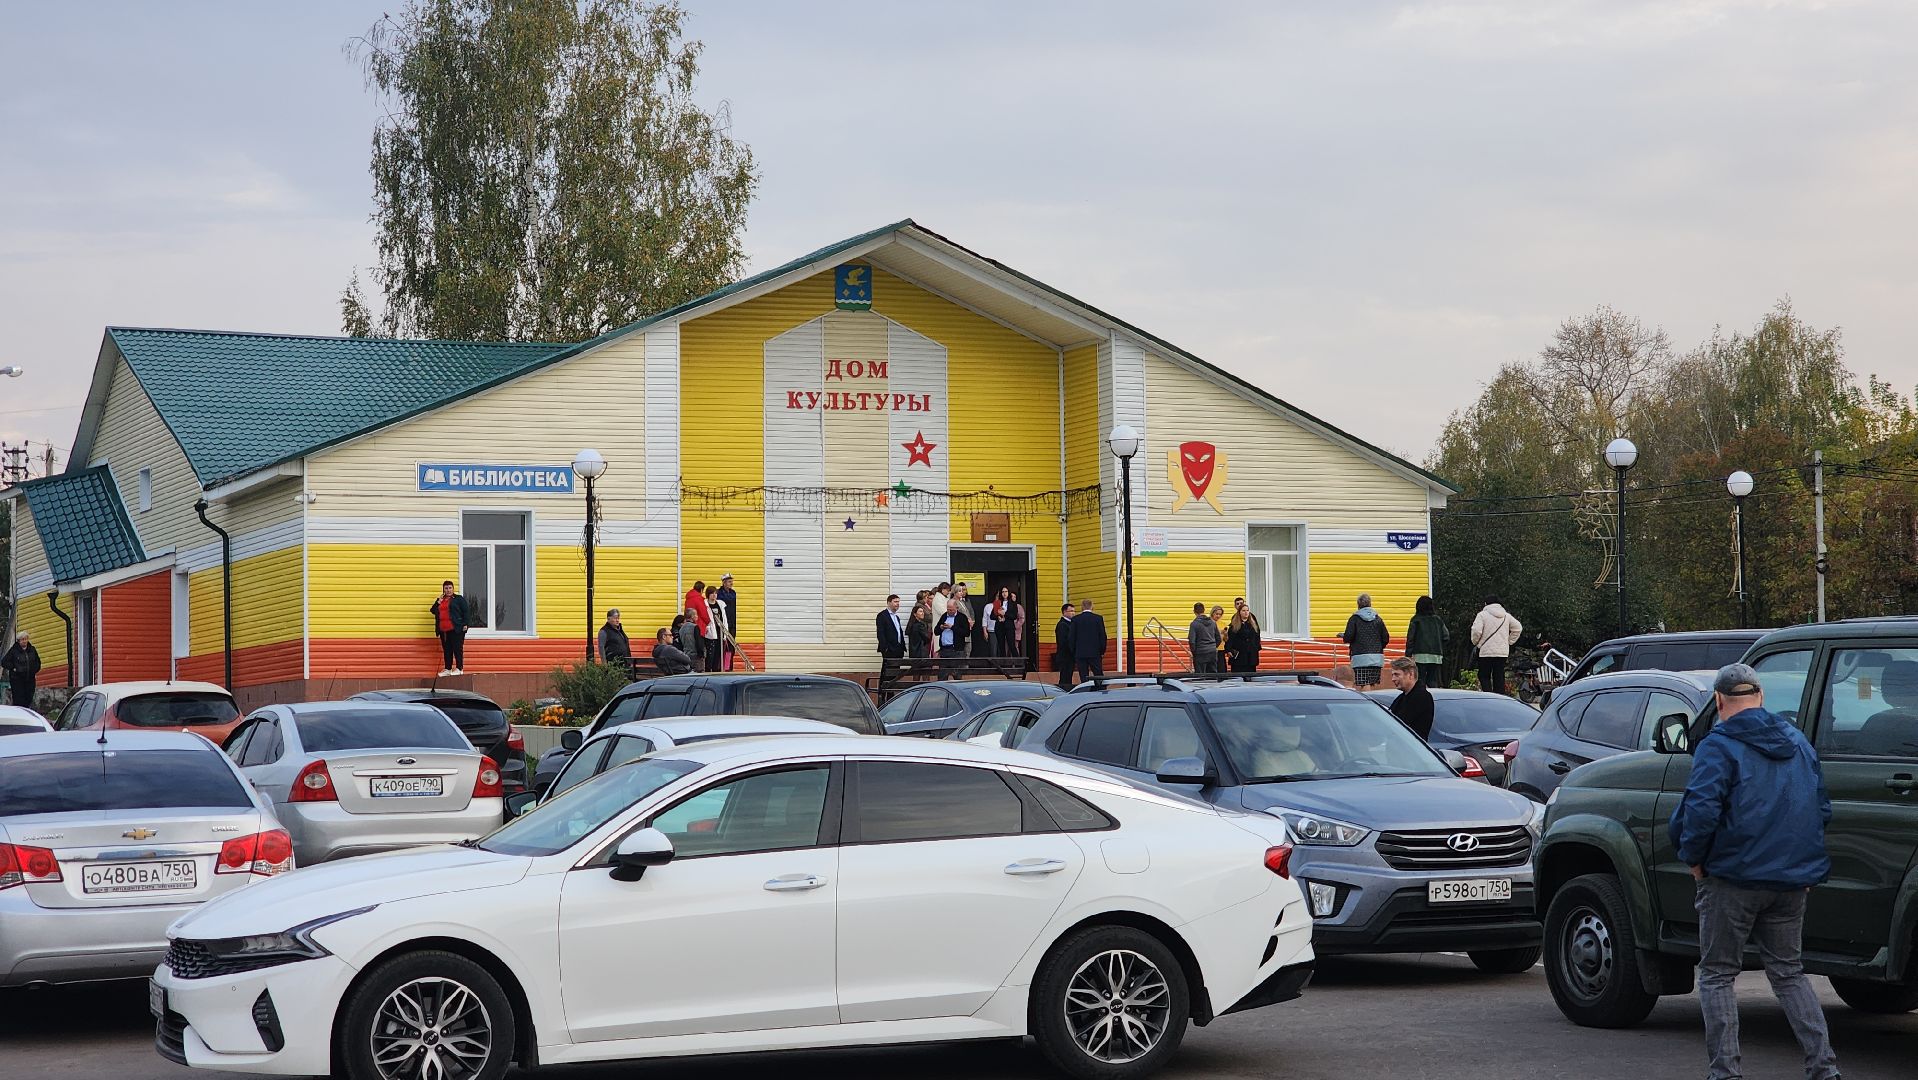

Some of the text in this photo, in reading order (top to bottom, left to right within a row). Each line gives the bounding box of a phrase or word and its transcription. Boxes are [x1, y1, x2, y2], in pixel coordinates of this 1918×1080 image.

[825, 359, 889, 381] ДОМ
[786, 390, 932, 412] КУЛЬТУРЫ
[449, 469, 569, 487] БИБЛИОТЕКА
[1403, 541, 1411, 549] 12
[421, 778, 438, 788] 790
[163, 863, 190, 877] 750
[1488, 880, 1508, 893] 750
